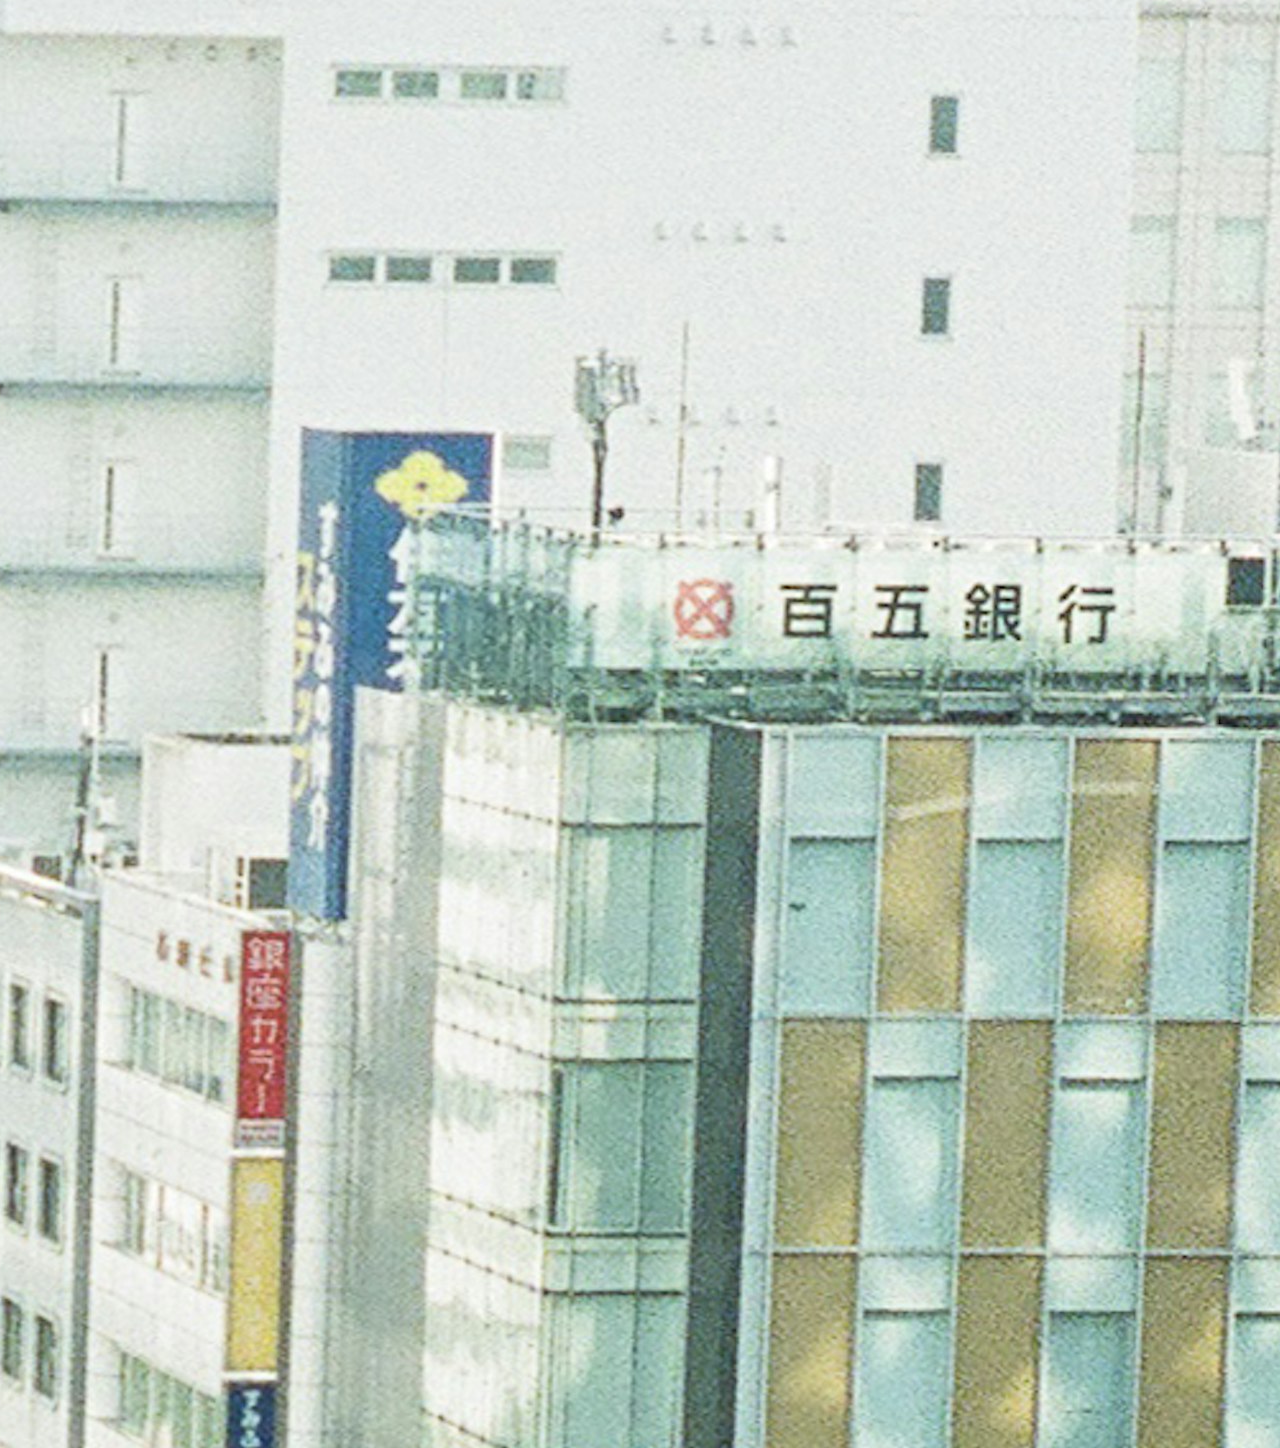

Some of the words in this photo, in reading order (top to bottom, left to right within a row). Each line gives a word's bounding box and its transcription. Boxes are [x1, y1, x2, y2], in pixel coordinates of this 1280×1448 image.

[779, 581, 1116, 644] 百五銀行
[245, 937, 287, 1114] 銀座カラー
